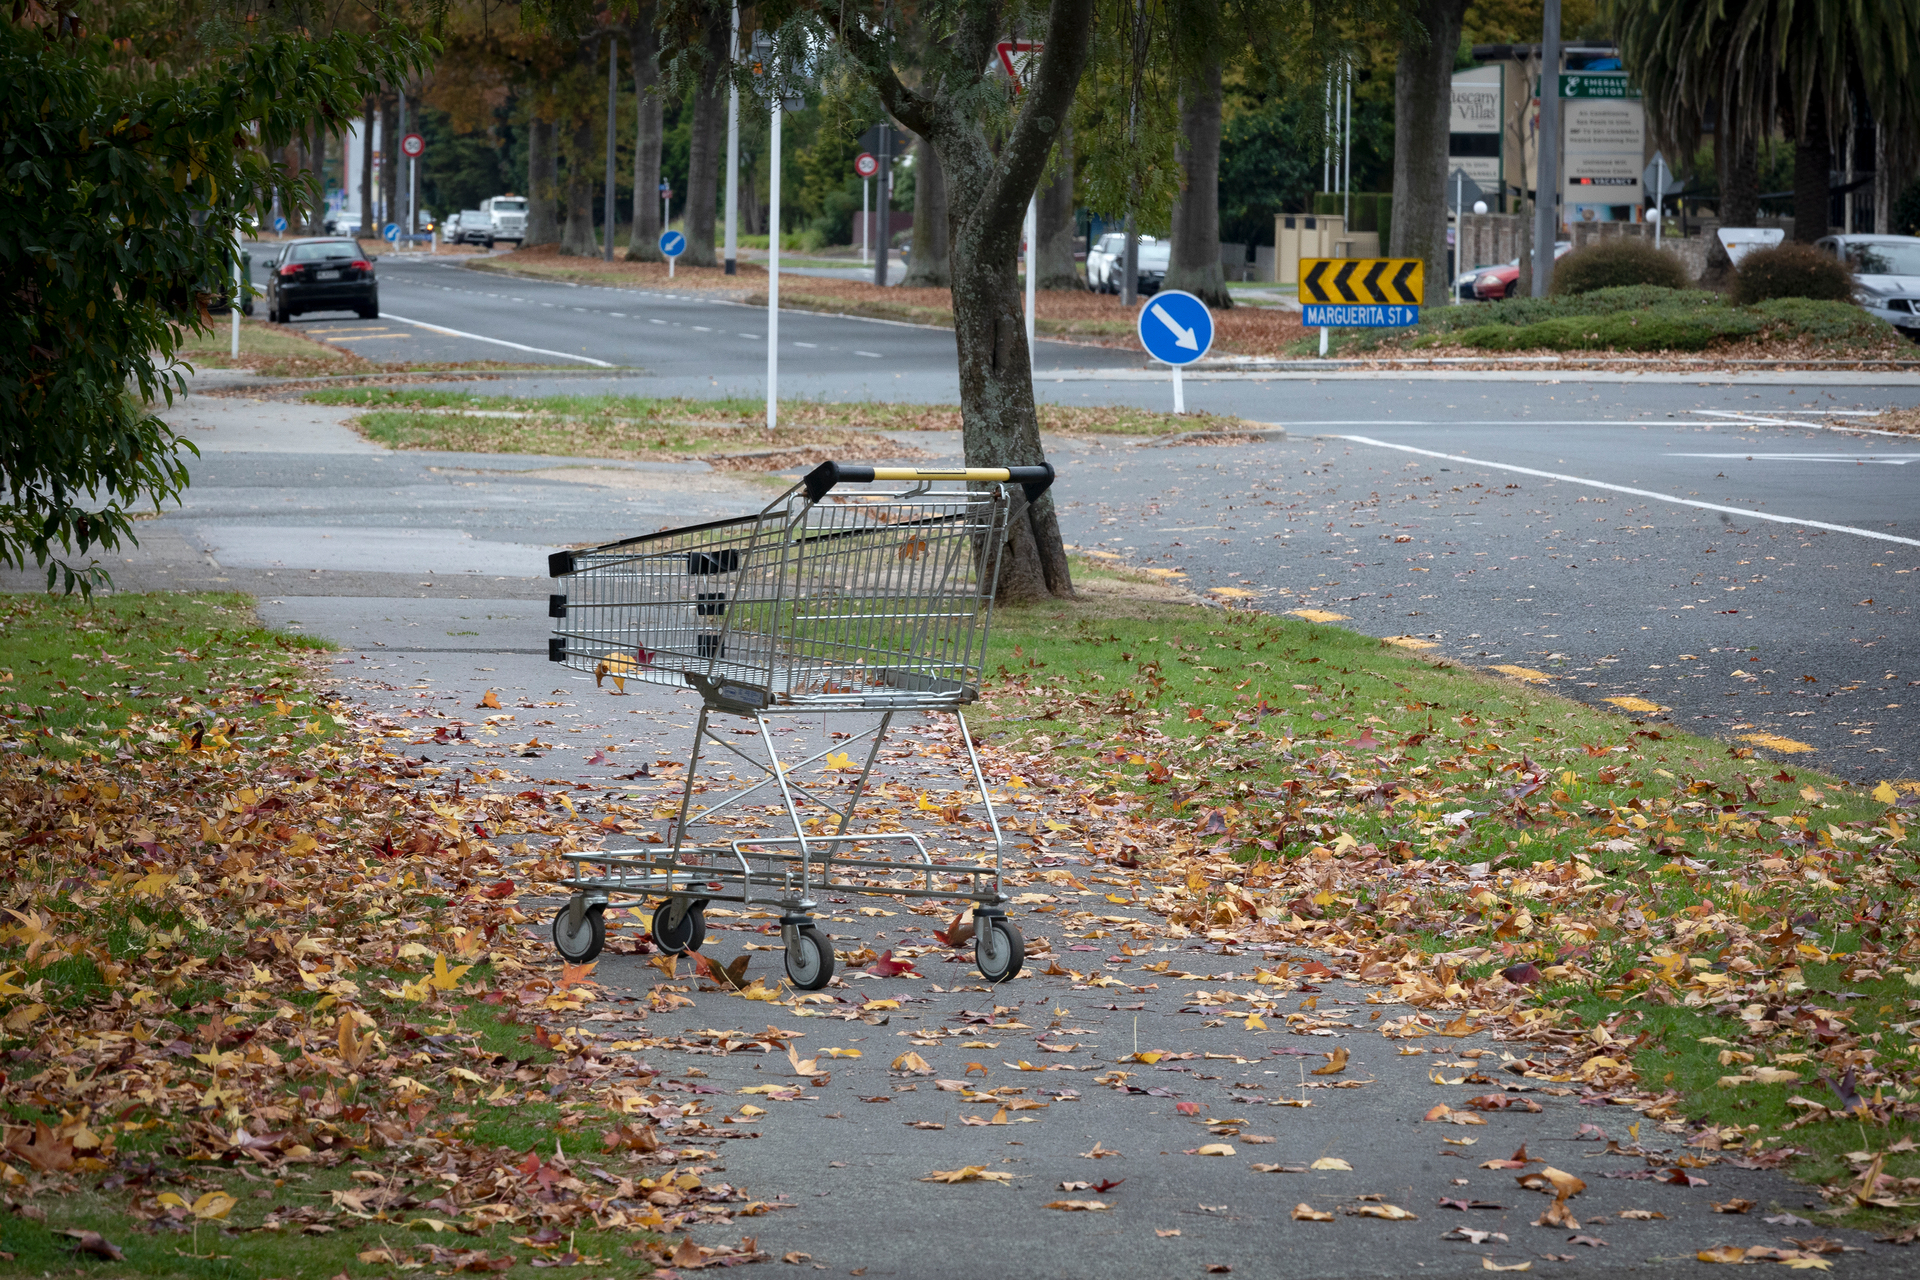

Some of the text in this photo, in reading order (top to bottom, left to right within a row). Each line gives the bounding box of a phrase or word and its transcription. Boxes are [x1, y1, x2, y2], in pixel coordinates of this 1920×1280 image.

[1583, 78, 1628, 88] EMERALD
[1451, 91, 1498, 108] uscany
[1588, 87, 1623, 96] MOTOR
[1458, 103, 1495, 119] Villas
[1307, 307, 1402, 324] MARGUERITA ST
